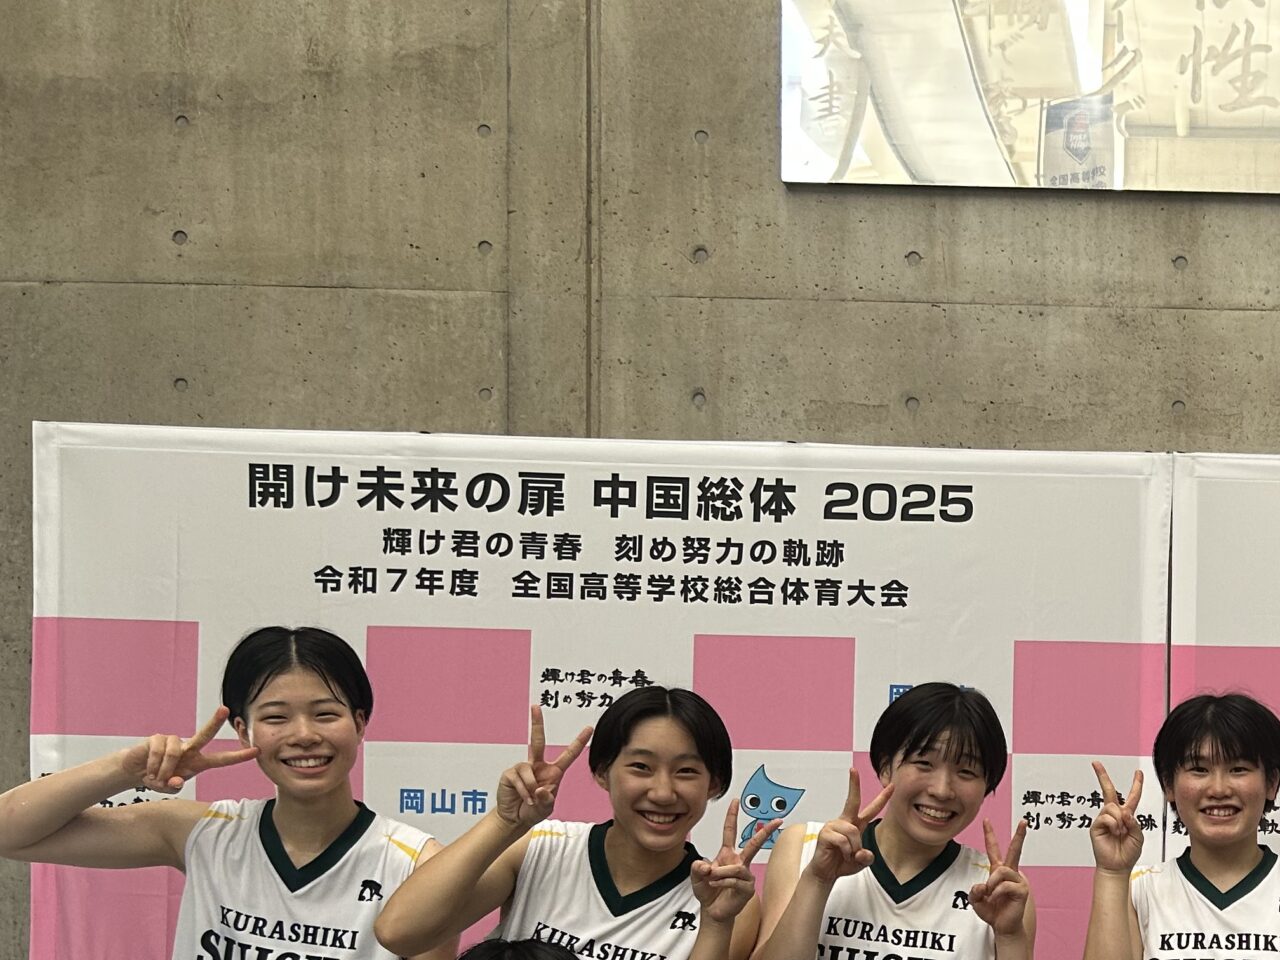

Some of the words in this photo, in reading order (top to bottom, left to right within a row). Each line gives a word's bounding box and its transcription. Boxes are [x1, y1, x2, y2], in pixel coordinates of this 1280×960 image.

[248, 462, 566, 517] 開け未来の扉
[593, 472, 797, 523] 中国総体
[823, 482, 974, 523] 2025
[382, 527, 582, 561] 輝け君の青春
[614, 533, 845, 568] 刻め努力の軌跡
[511, 570, 909, 608] 全国高等学校総合体育大会
[540, 667, 655, 688] 輝け君の青春
[399, 788, 488, 815] 岡山市
[1022, 811, 1158, 831] 刻め努力跡
[220, 905, 359, 951] KURASHIKI
[825, 916, 957, 953] KURASHIKI
